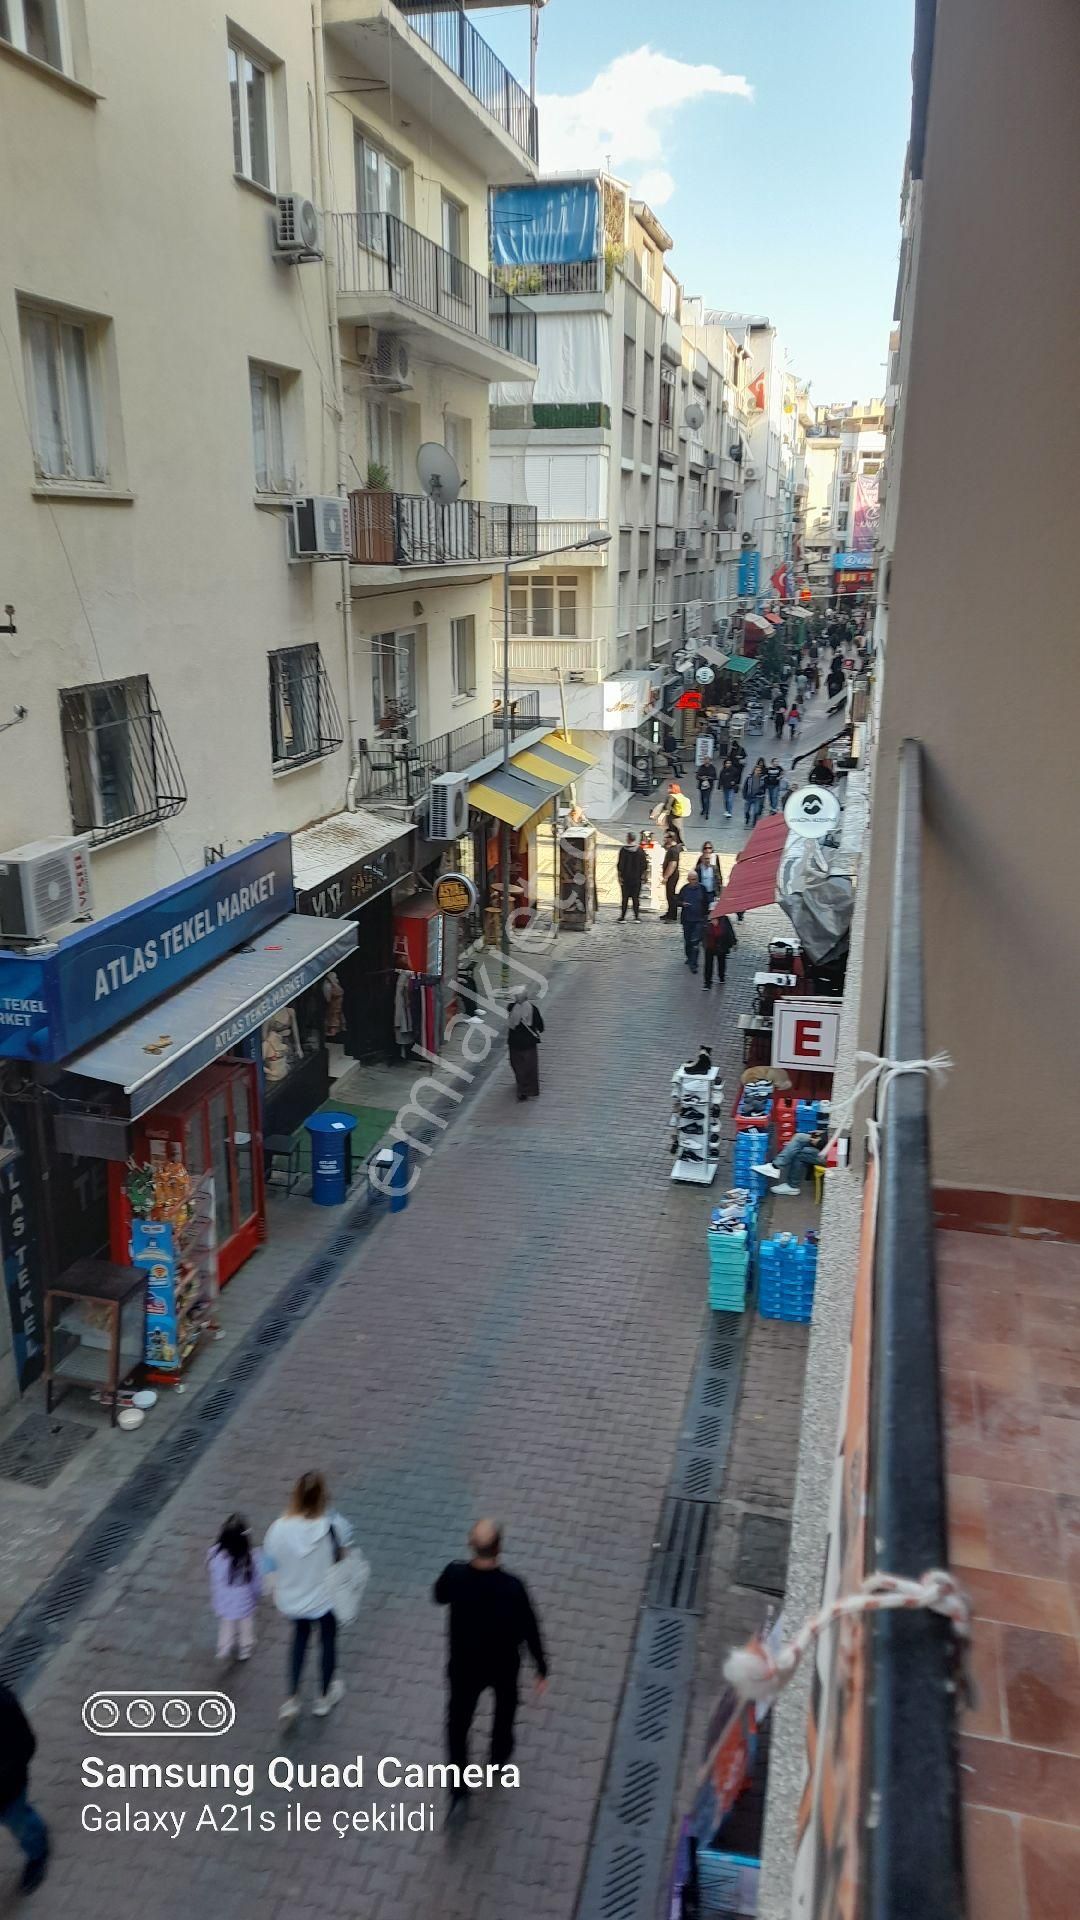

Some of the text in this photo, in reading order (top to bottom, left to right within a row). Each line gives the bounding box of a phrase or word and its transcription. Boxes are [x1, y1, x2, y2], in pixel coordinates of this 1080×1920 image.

[95, 940, 158, 1001] ATLAS
[160, 909, 216, 959] TEKEL
[217, 871, 275, 927] MARKET
[3, 998, 48, 1013] TEKEL
[214, 972, 305, 1051] ATLAS TEKEL MARKET
[794, 1020, 823, 1057] E
[13, 1245, 40, 1358] TEKEL
